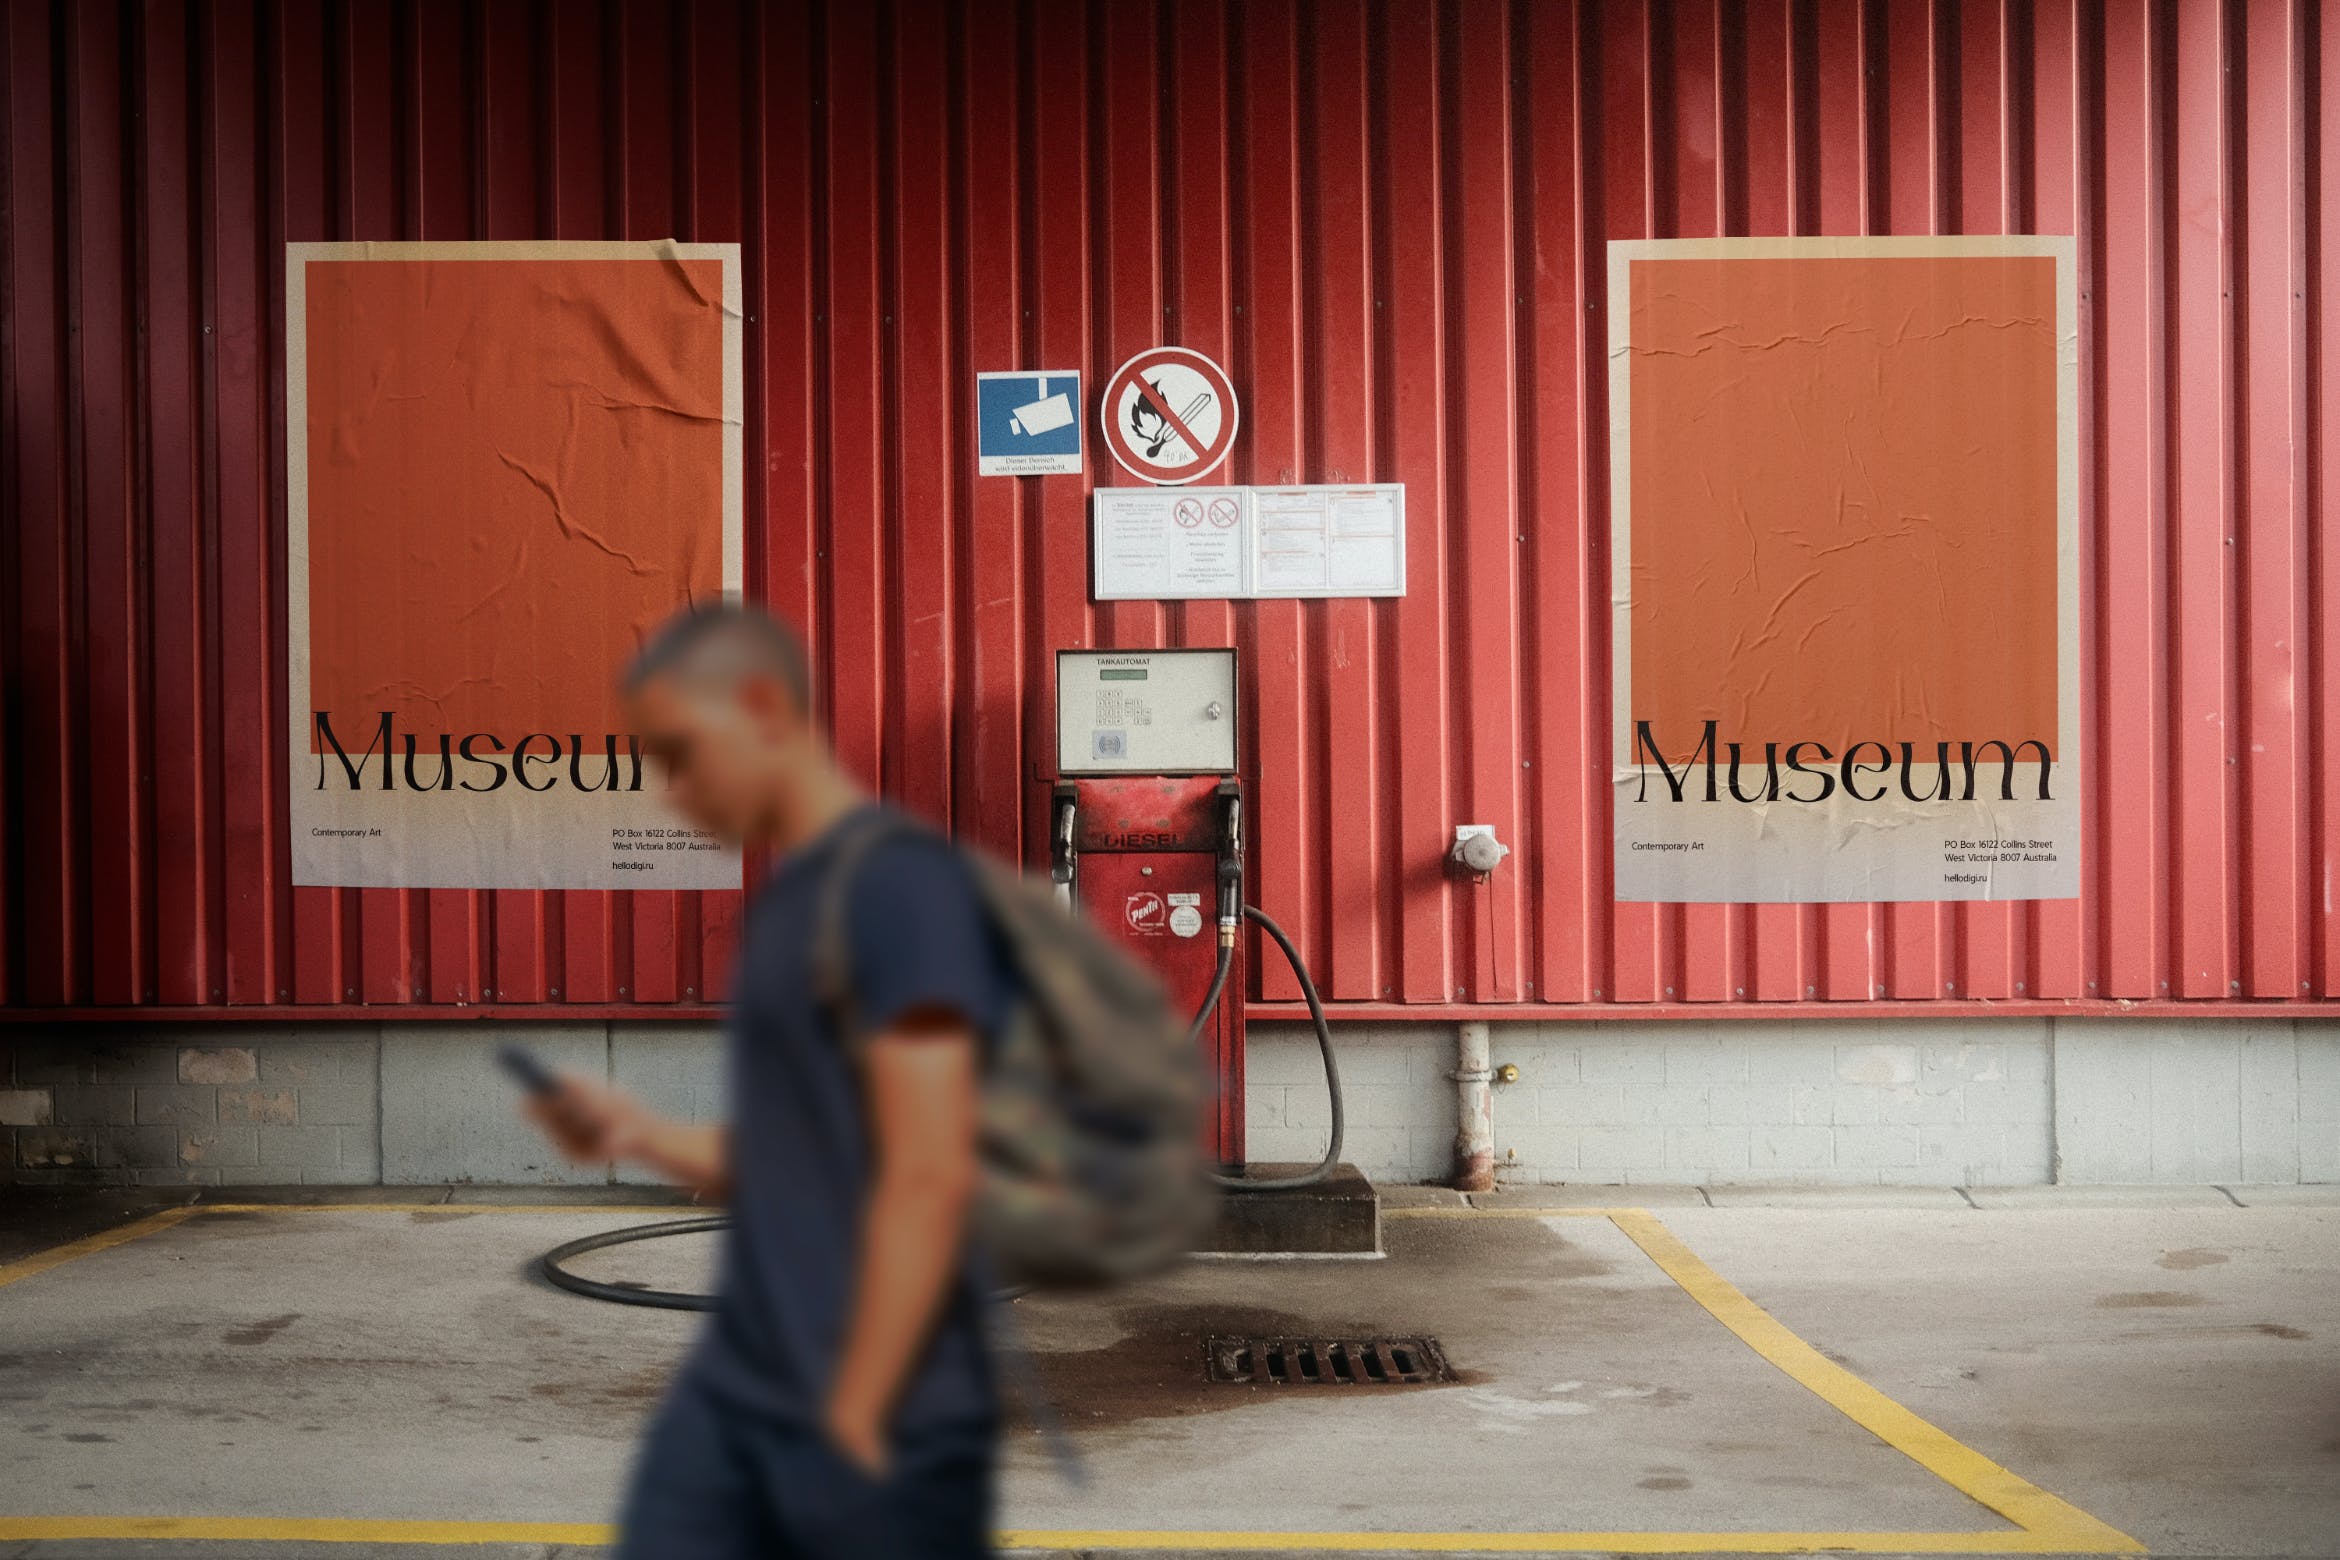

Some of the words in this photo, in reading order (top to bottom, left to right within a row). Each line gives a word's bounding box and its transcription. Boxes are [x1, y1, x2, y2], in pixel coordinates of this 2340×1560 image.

[1633, 720, 2056, 802] Museum
[311, 827, 367, 838] Contemporary
[369, 827, 382, 837] Art
[612, 829, 626, 838] PO
[627, 829, 643, 838] Box
[645, 829, 665, 838] 16122
[667, 829, 691, 838] Collins
[1104, 833, 1181, 848] DIESEL
[1944, 840, 1958, 849] PO
[1960, 840, 1976, 849] Box
[1978, 840, 1999, 849] 16122
[2000, 840, 2026, 849] Collins
[2028, 840, 2053, 849] Street
[612, 842, 632, 851] West
[635, 842, 664, 851] Victoria
[666, 842, 686, 851] 8007
[688, 842, 721, 851] Australia
[1631, 841, 1689, 853] Contemporary
[1691, 841, 1704, 850] Art
[1944, 854, 1965, 862] West
[1968, 853, 1998, 862] Victoria
[2000, 853, 2021, 862] 8007
[2023, 853, 2057, 862] Australia
[612, 861, 654, 871] hellodigi.ru
[1944, 873, 1988, 885] hellodigi.ru
